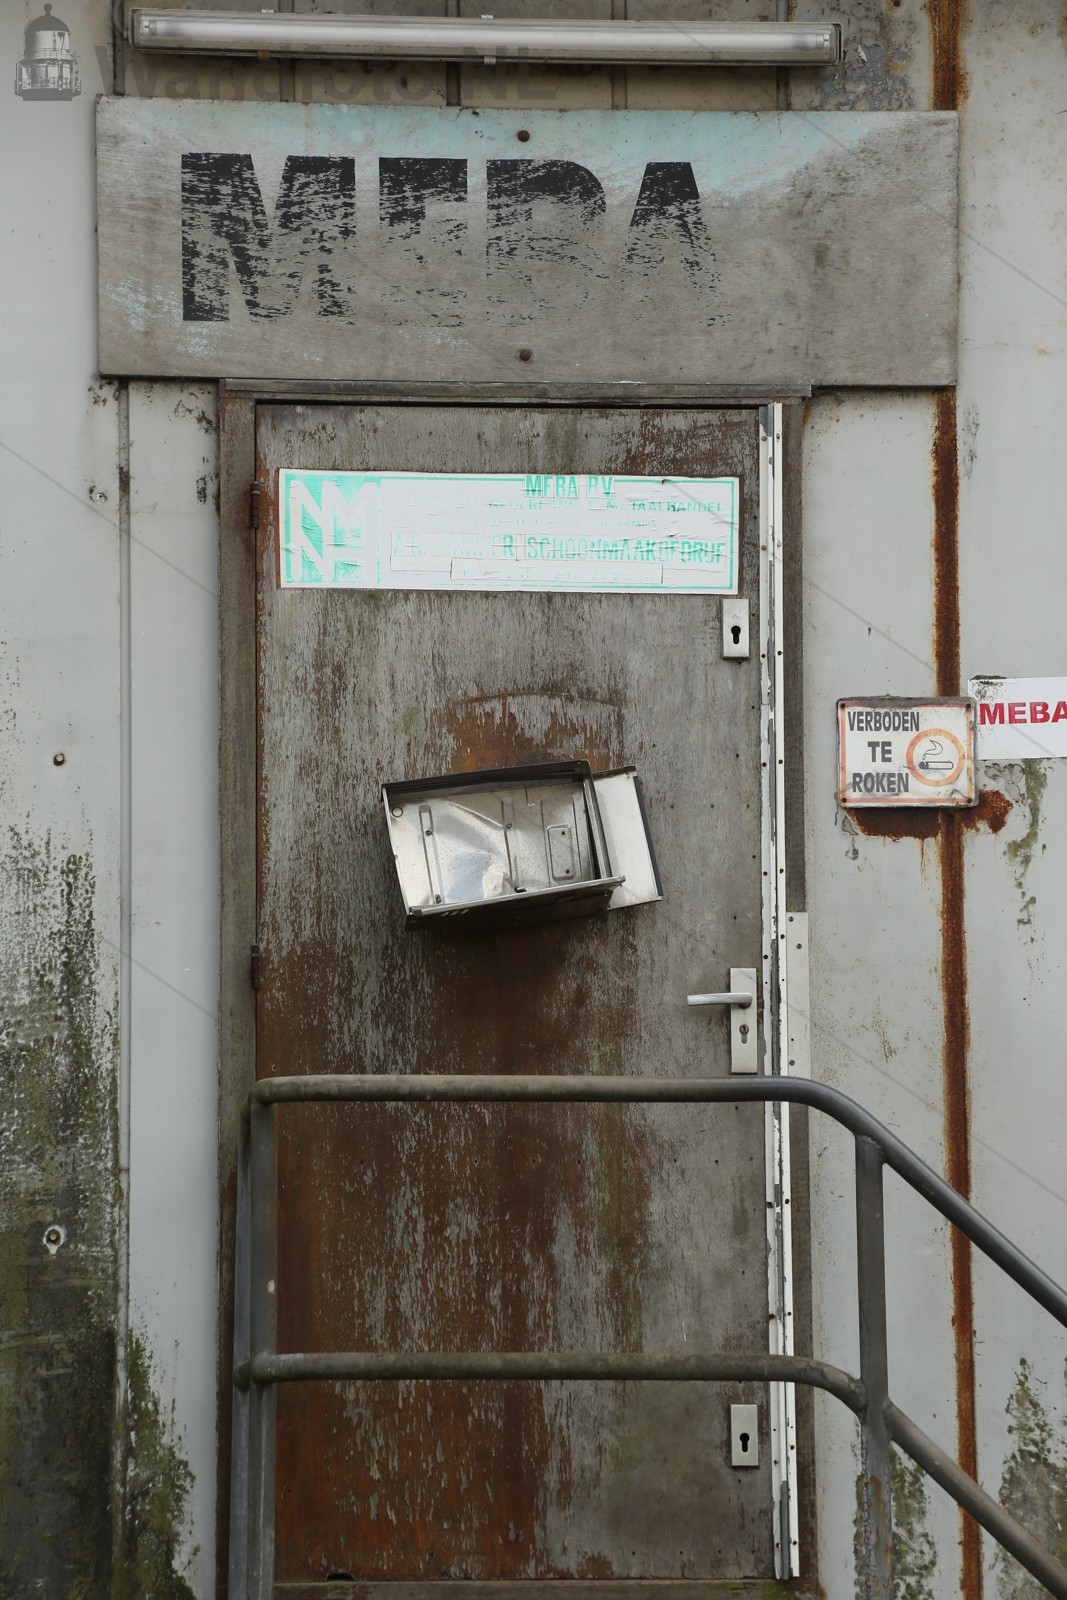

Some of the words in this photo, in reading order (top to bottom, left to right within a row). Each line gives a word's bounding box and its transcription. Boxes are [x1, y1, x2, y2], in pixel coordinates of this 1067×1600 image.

[847, 711, 920, 732] VERBODEN
[979, 701, 1067, 725] MEBA
[867, 741, 892, 763] TE
[852, 772, 909, 793] ROKEN
